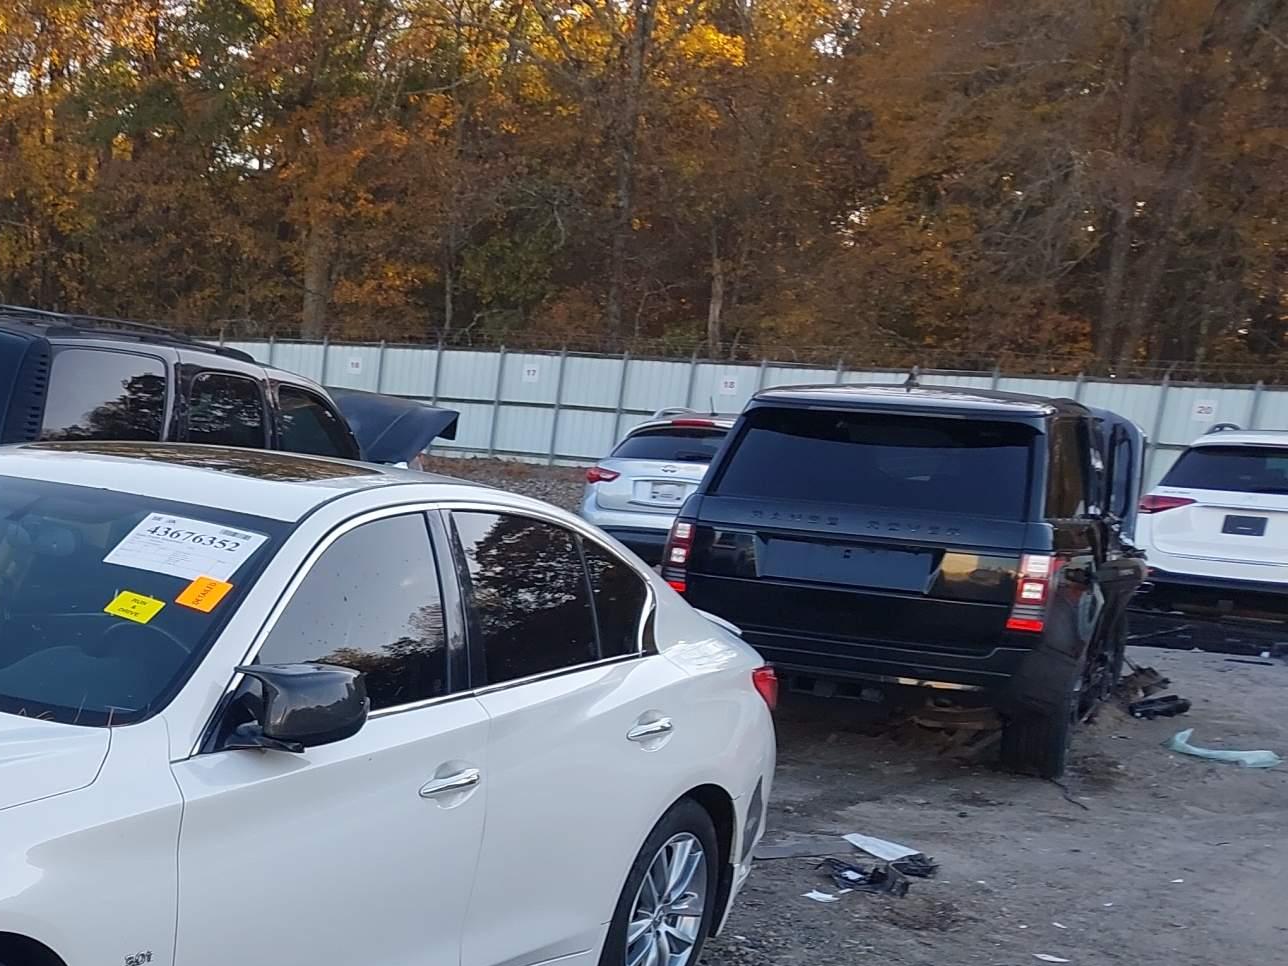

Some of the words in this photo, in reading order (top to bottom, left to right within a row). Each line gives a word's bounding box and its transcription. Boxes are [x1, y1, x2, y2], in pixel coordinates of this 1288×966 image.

[751, 509, 840, 526] RANGE
[866, 519, 961, 536] ROVER
[146, 525, 241, 551] 43676352
[131, 598, 148, 606] RUN
[117, 607, 140, 617] DRIVE
